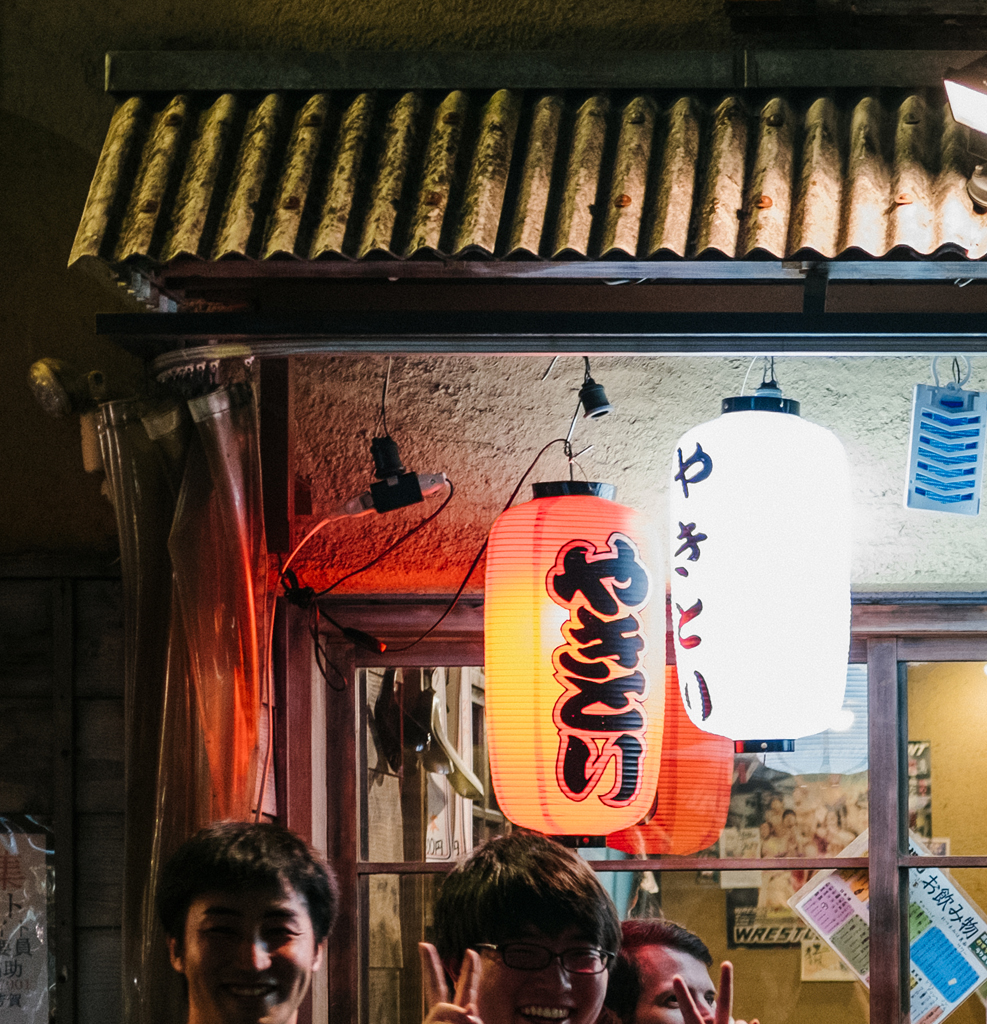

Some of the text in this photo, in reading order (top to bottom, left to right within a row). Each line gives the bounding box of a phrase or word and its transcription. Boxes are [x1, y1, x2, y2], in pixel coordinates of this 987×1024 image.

[546, 532, 652, 807] やきとり
[922, 874, 980, 940] お飲み物
